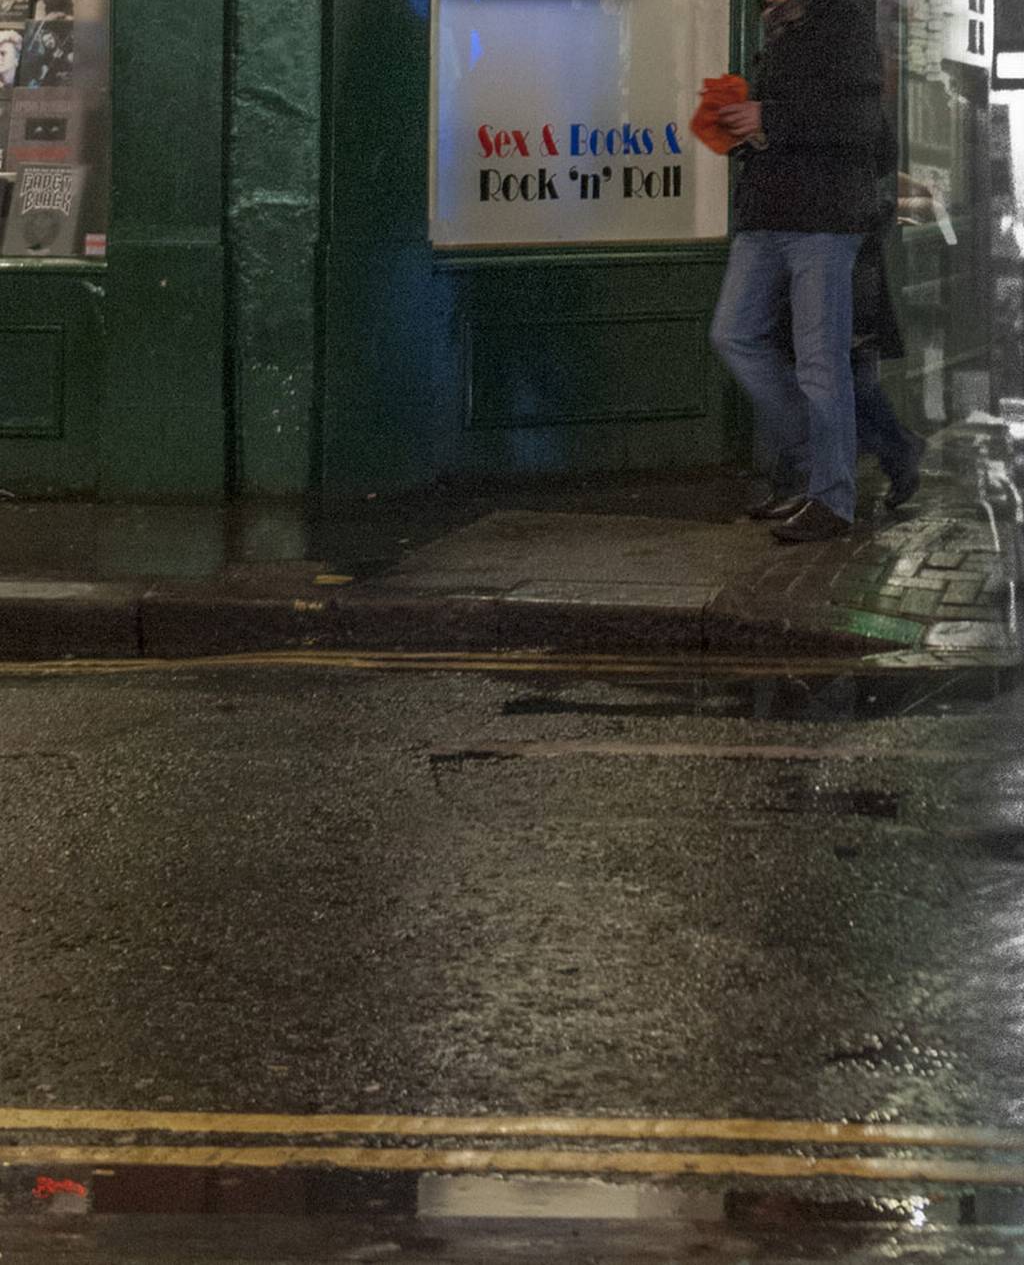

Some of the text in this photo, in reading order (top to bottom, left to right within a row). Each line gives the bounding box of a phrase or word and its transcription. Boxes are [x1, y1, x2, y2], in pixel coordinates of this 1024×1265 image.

[477, 121, 682, 158] Sex & Books &
[479, 168, 559, 202] Rock
[623, 165, 682, 199] Roll
